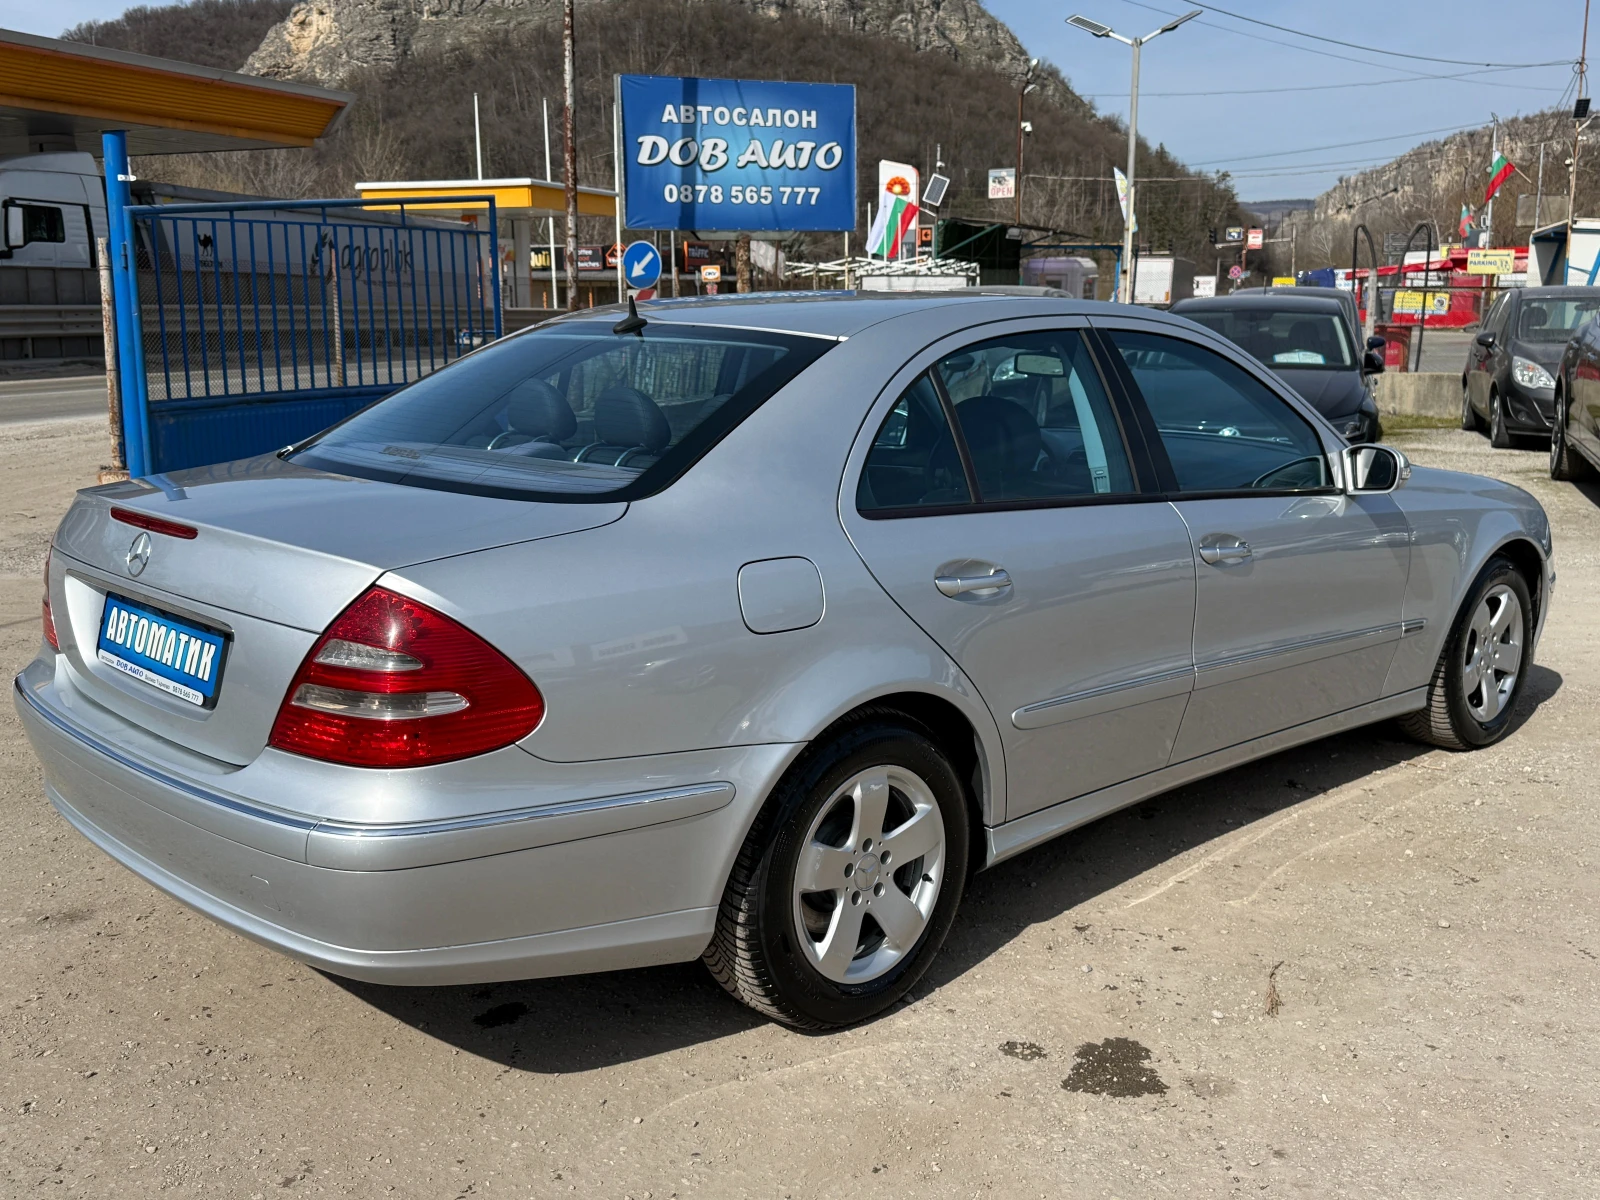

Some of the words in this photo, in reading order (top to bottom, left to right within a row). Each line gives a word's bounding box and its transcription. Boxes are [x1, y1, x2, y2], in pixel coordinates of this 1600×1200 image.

[661, 104, 818, 129] АВТОСАЛОН
[636, 135, 729, 171] DOB
[736, 139, 843, 170] AUTO
[663, 183, 724, 204] 0878
[730, 185, 773, 205] 565
[779, 187, 821, 205] 777
[990, 187, 1012, 196] OPEN
[106, 606, 217, 682] АВТОМАТИК
